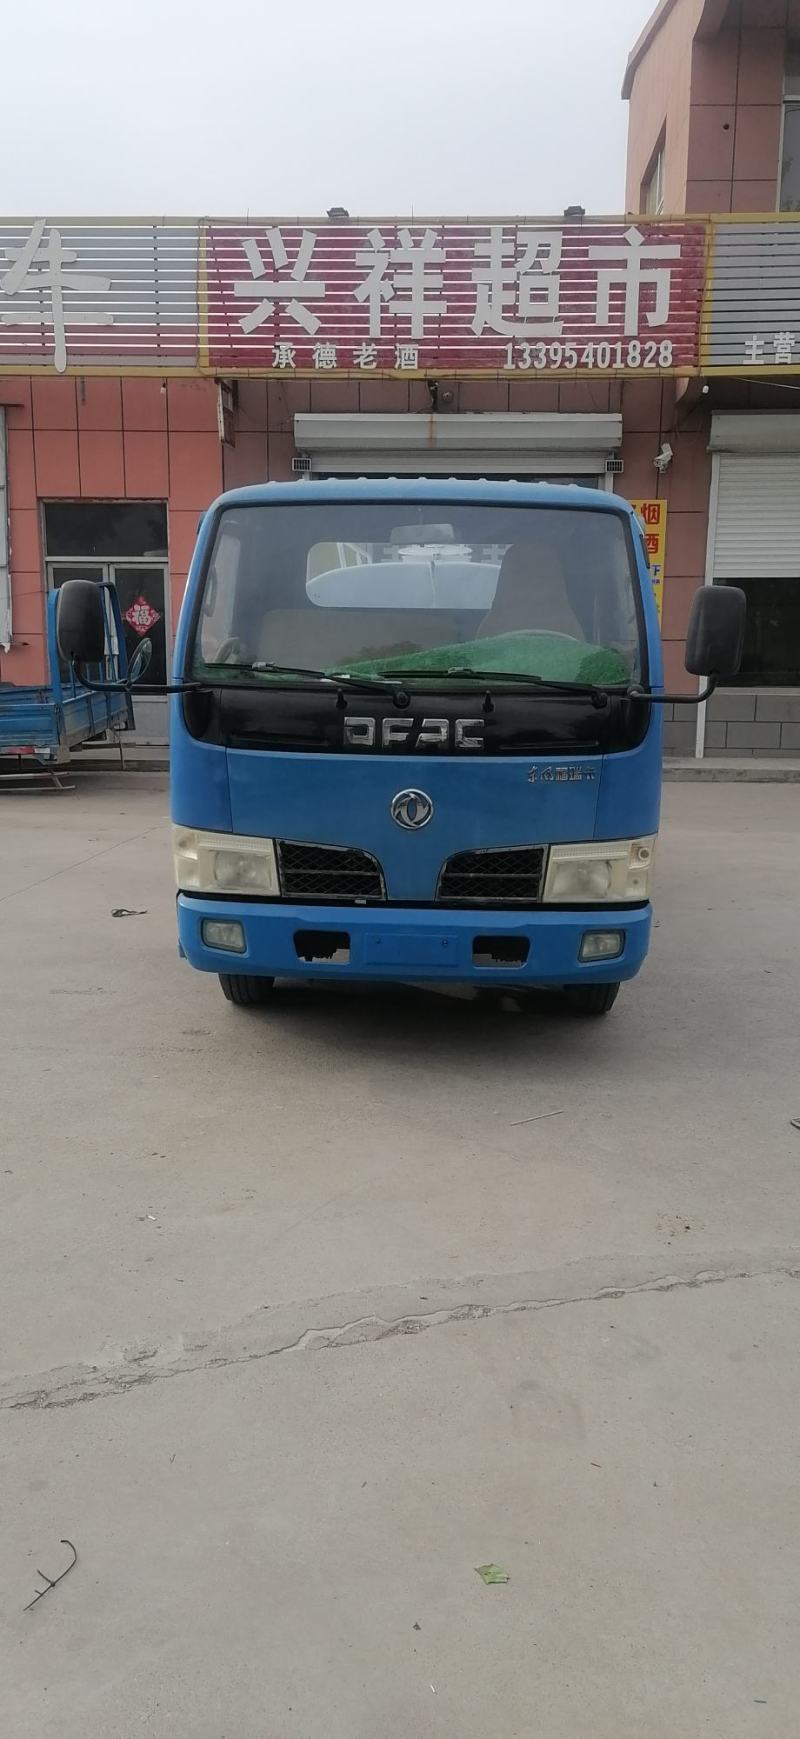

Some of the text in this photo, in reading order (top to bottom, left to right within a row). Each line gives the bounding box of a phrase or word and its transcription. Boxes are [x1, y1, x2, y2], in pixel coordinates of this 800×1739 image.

[233, 226, 682, 339] 兴祥超市
[272, 342, 419, 370] 承德老酒
[503, 340, 674, 370] 13395401828
[743, 332, 795, 364] 主营
[133, 604, 151, 625] 福
[343, 716, 485, 748] DFAC
